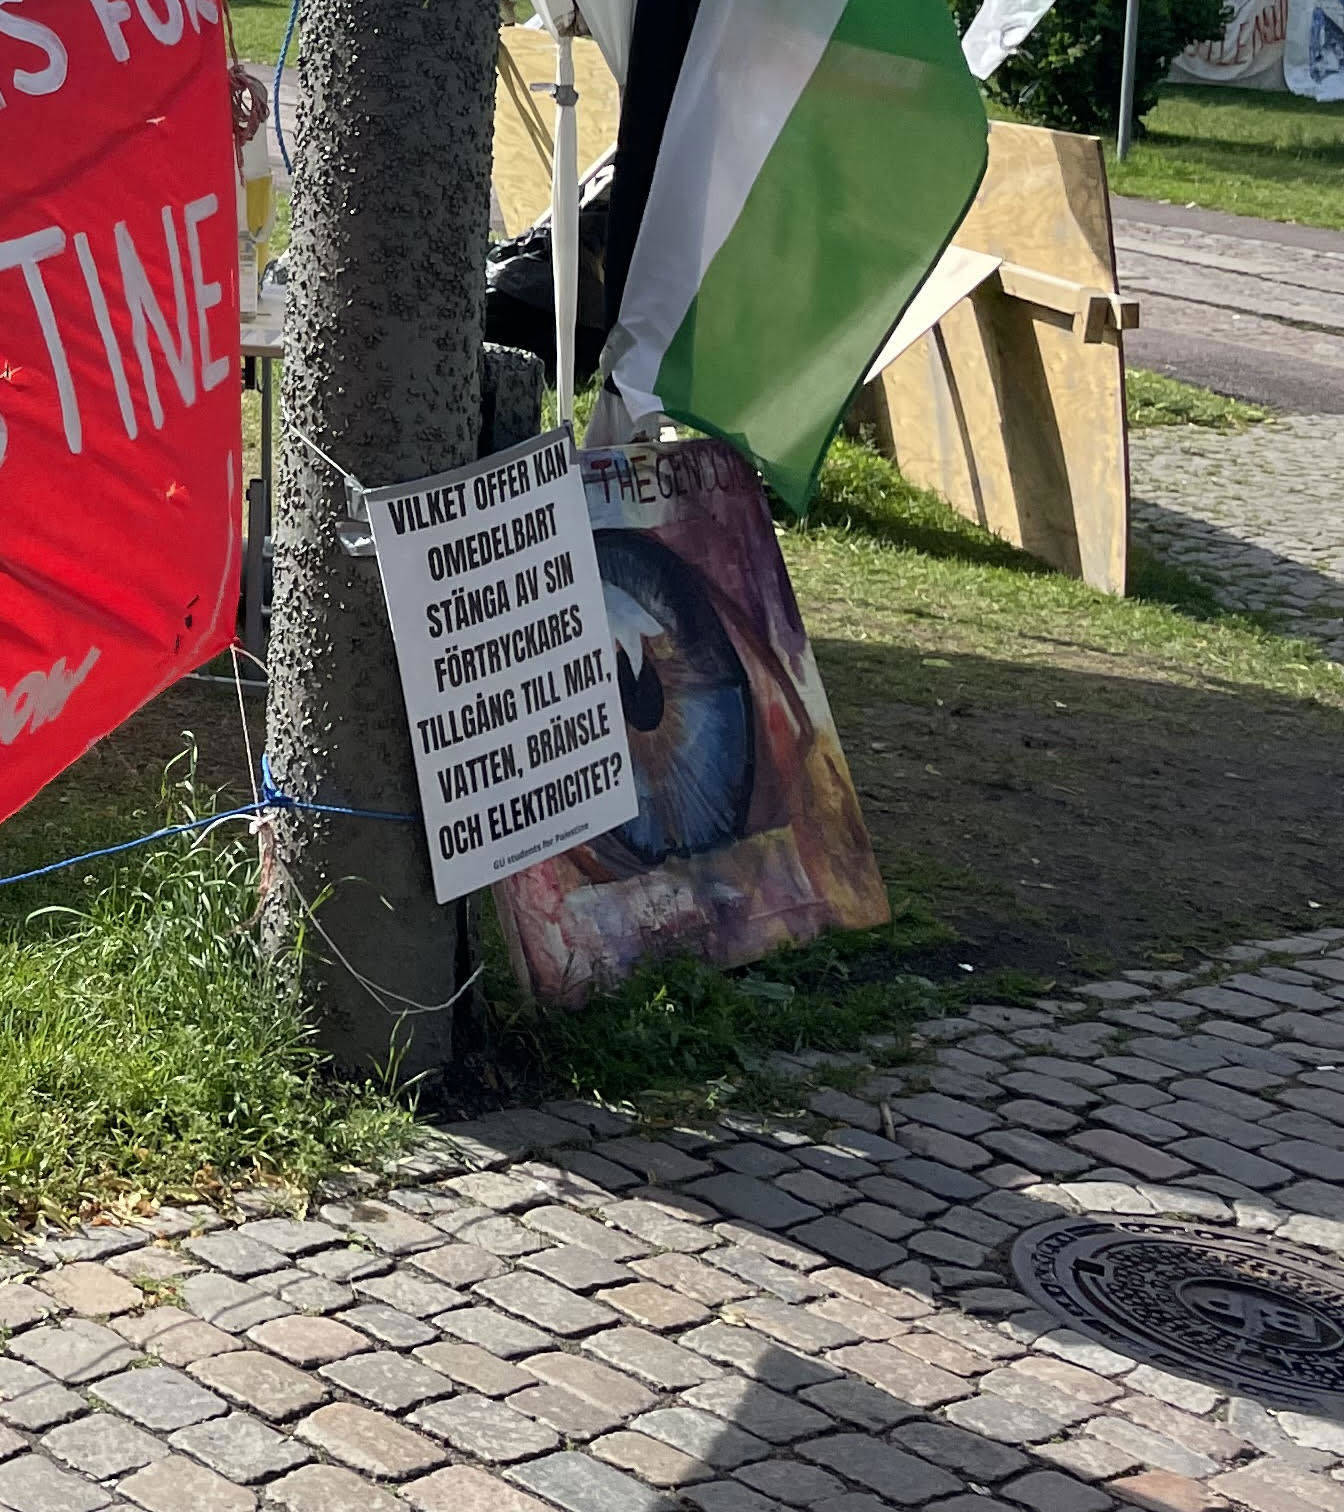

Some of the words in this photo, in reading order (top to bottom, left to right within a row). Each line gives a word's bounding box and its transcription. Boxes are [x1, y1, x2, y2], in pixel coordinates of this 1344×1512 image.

[387, 482, 467, 535] VILKET
[473, 459, 531, 510] OFFER
[532, 441, 568, 487] KAN
[591, 454, 655, 504] THE
[427, 502, 557, 581] OMEDELBART
[426, 586, 511, 638] STÄNGA
[516, 566, 540, 607] AV
[543, 551, 574, 594] SIN
[433, 604, 583, 692] FÖRTRYCKARES
[417, 692, 517, 755] TILLGÅNG
[521, 671, 561, 715] TILL
[563, 649, 612, 698] MAT,
[437, 744, 523, 804] VATTEN,
[526, 702, 610, 769] BRÄNSLE
[439, 813, 484, 861] OCH
[487, 752, 623, 842] ELEKTRICITET?
[493, 858, 506, 870] GU
[507, 844, 542, 865] students
[555, 822, 590, 843] Palestine
